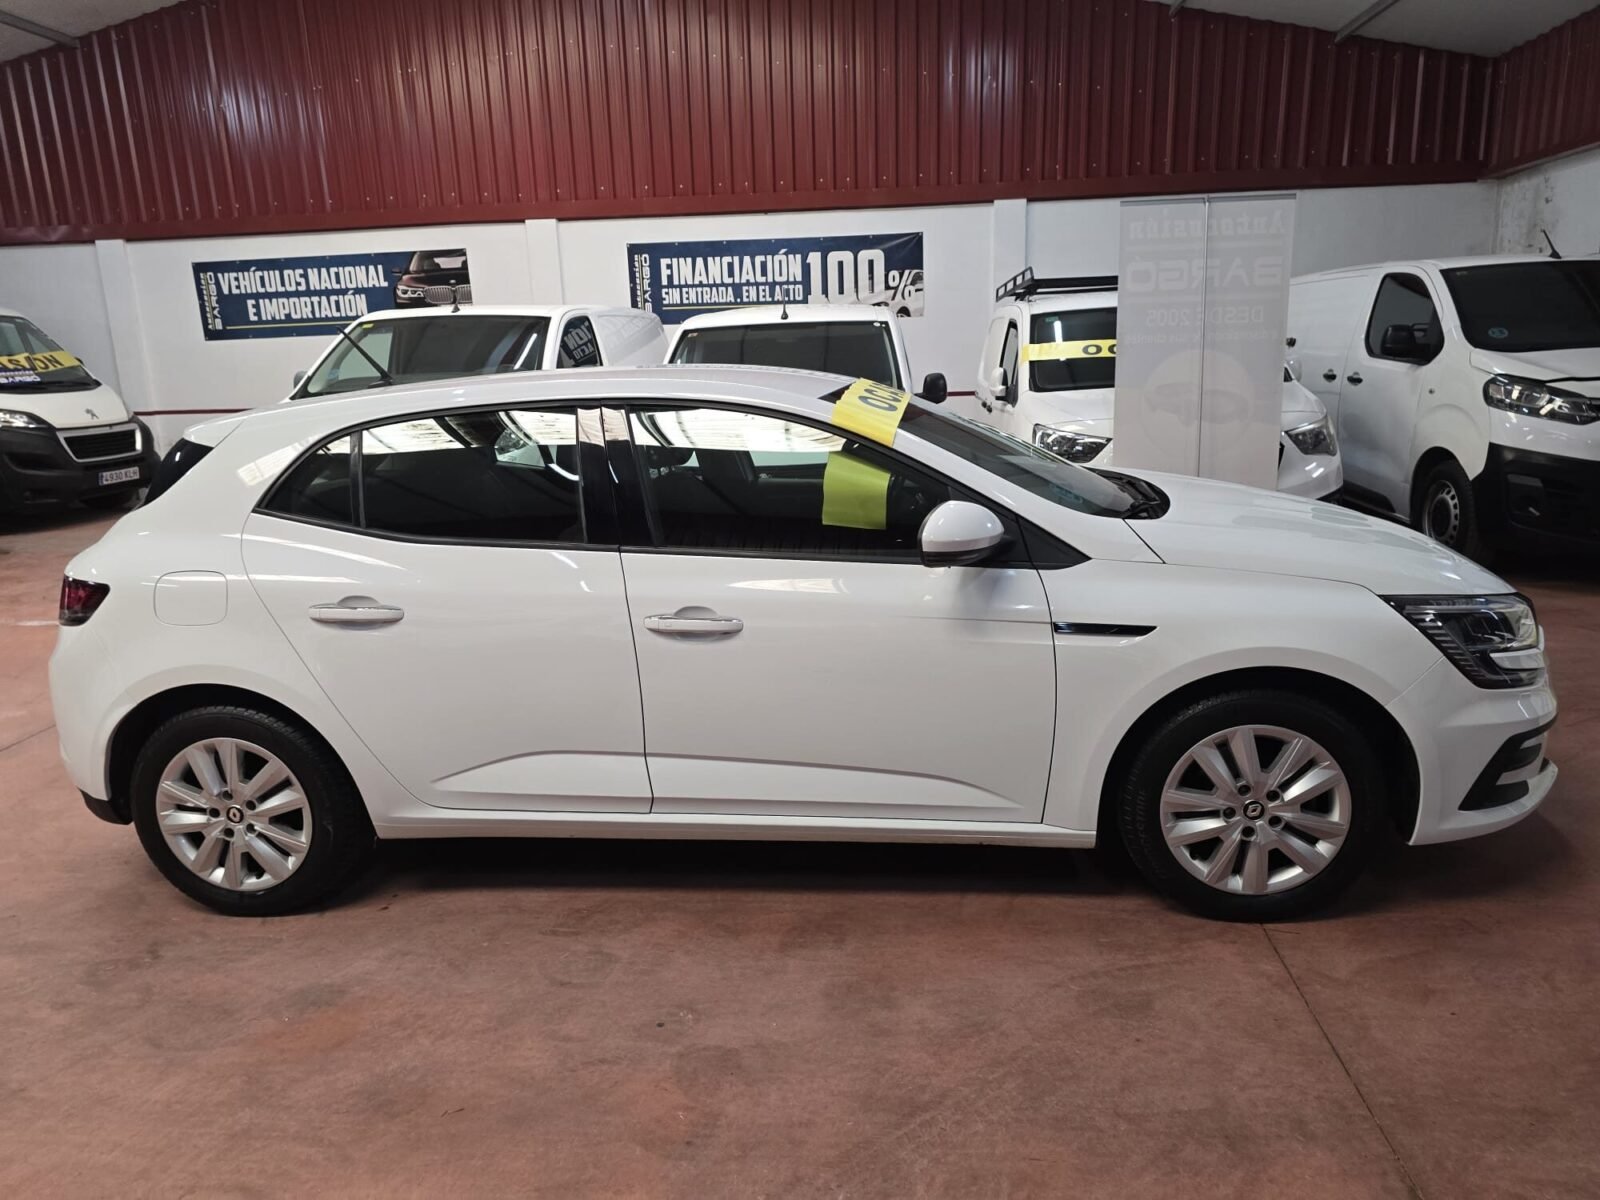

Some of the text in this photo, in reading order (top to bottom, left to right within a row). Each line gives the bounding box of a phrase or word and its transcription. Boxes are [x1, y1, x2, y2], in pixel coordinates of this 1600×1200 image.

[217, 264, 388, 295] VEHÍCULOS NACIONAL
[660, 249, 803, 286] FINANCIACIÓN
[247, 290, 369, 321] E IMPORTACIÓN
[661, 287, 681, 305] SIN
[742, 286, 757, 303] EN
[758, 286, 773, 303] EL
[775, 284, 803, 303] ACTO
